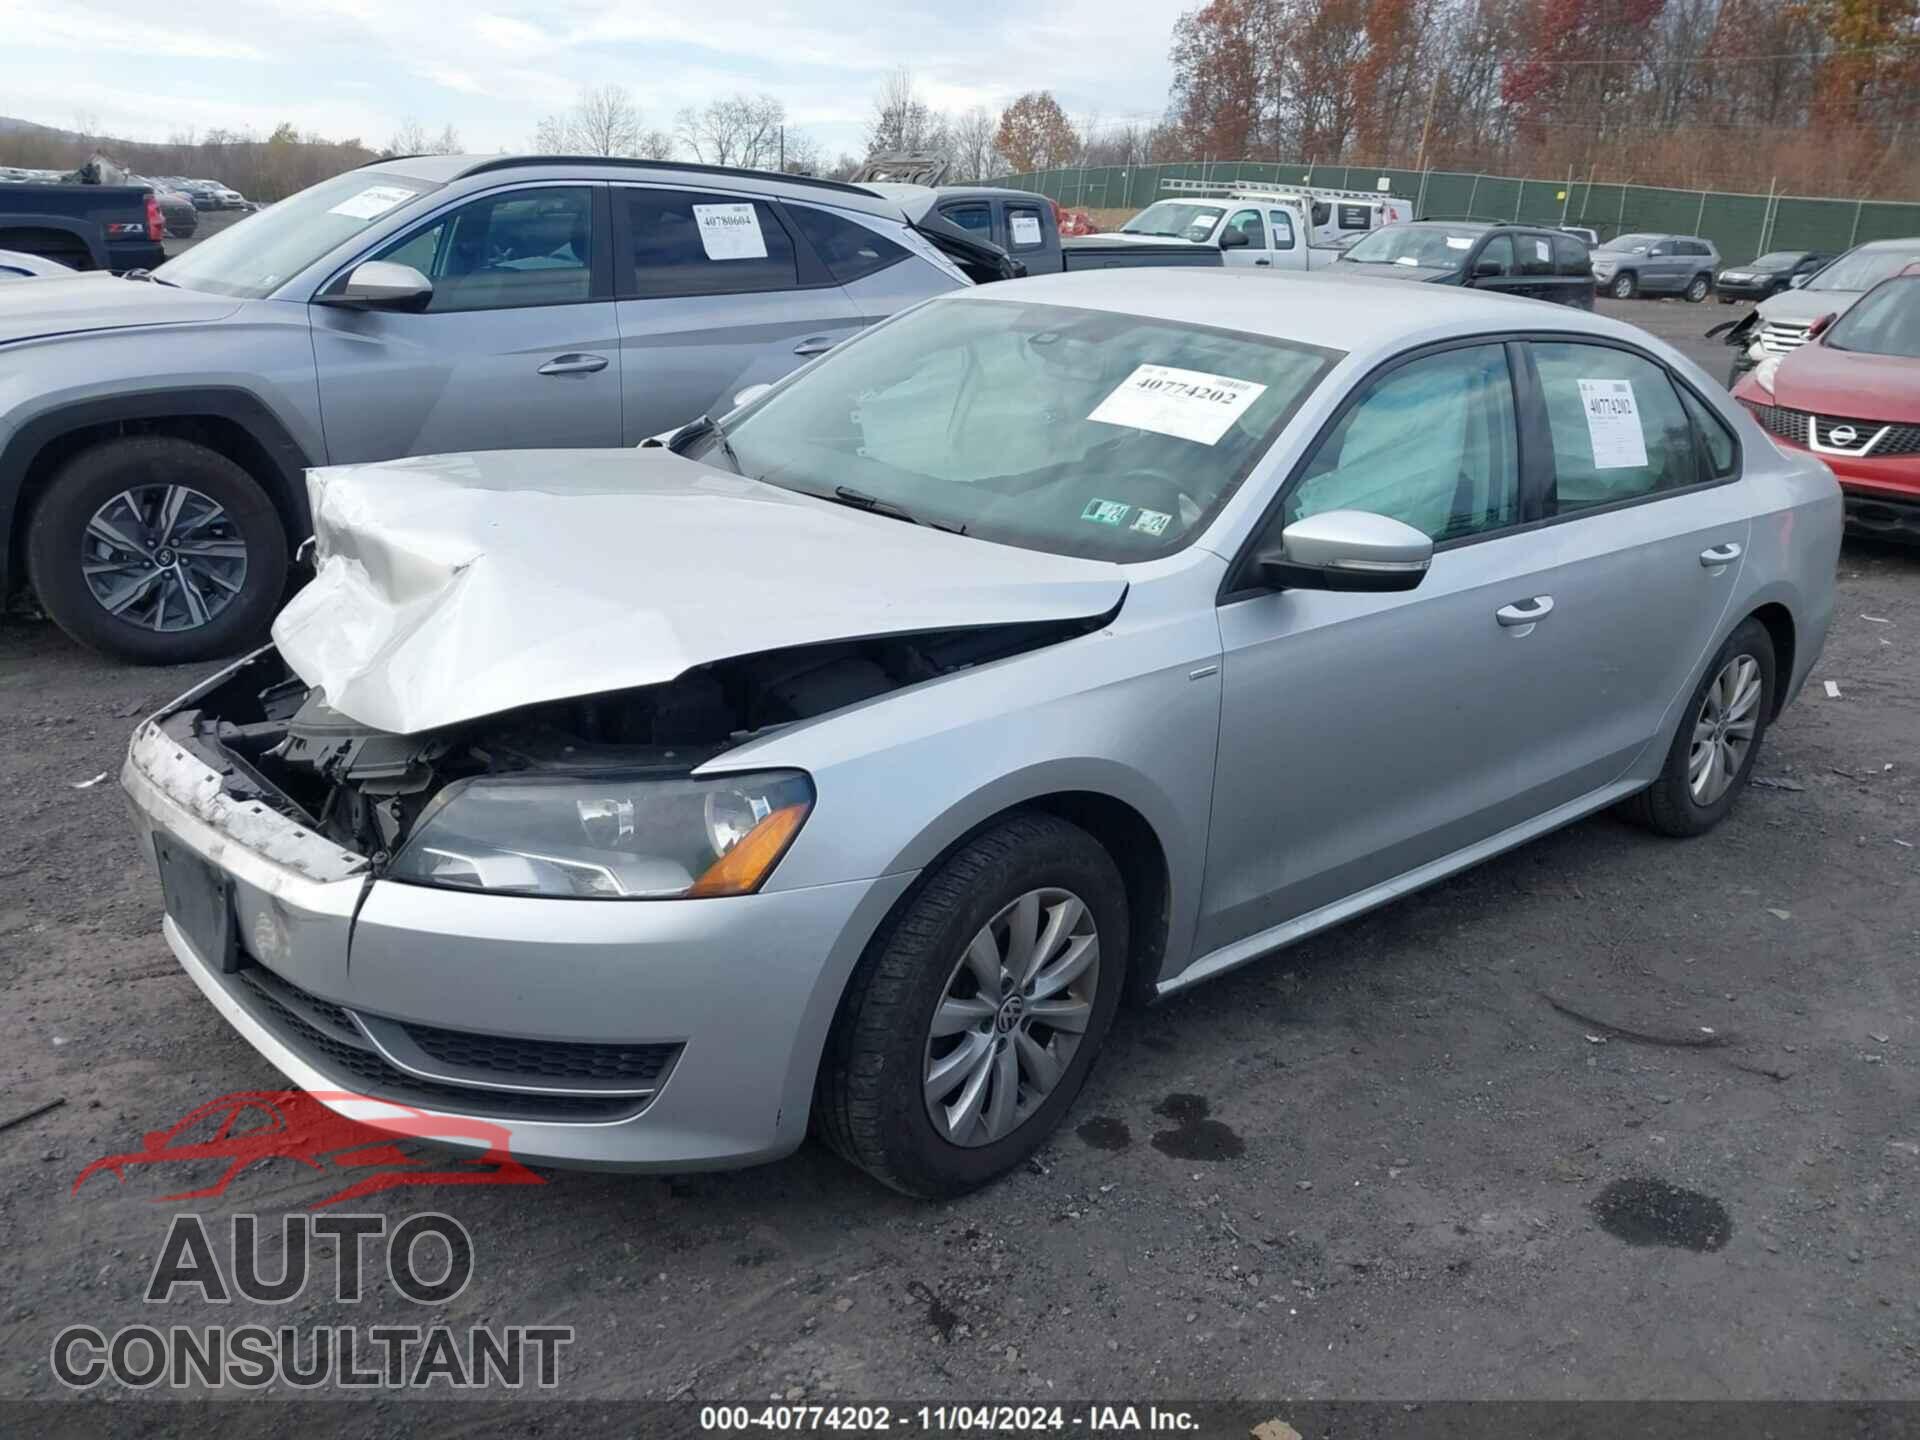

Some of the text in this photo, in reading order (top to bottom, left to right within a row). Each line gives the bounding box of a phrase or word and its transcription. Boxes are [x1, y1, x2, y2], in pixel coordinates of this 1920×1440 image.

[107, 223, 145, 233] Z71
[1136, 377, 1237, 404] 40774202
[1589, 398, 1633, 415] 40774202
